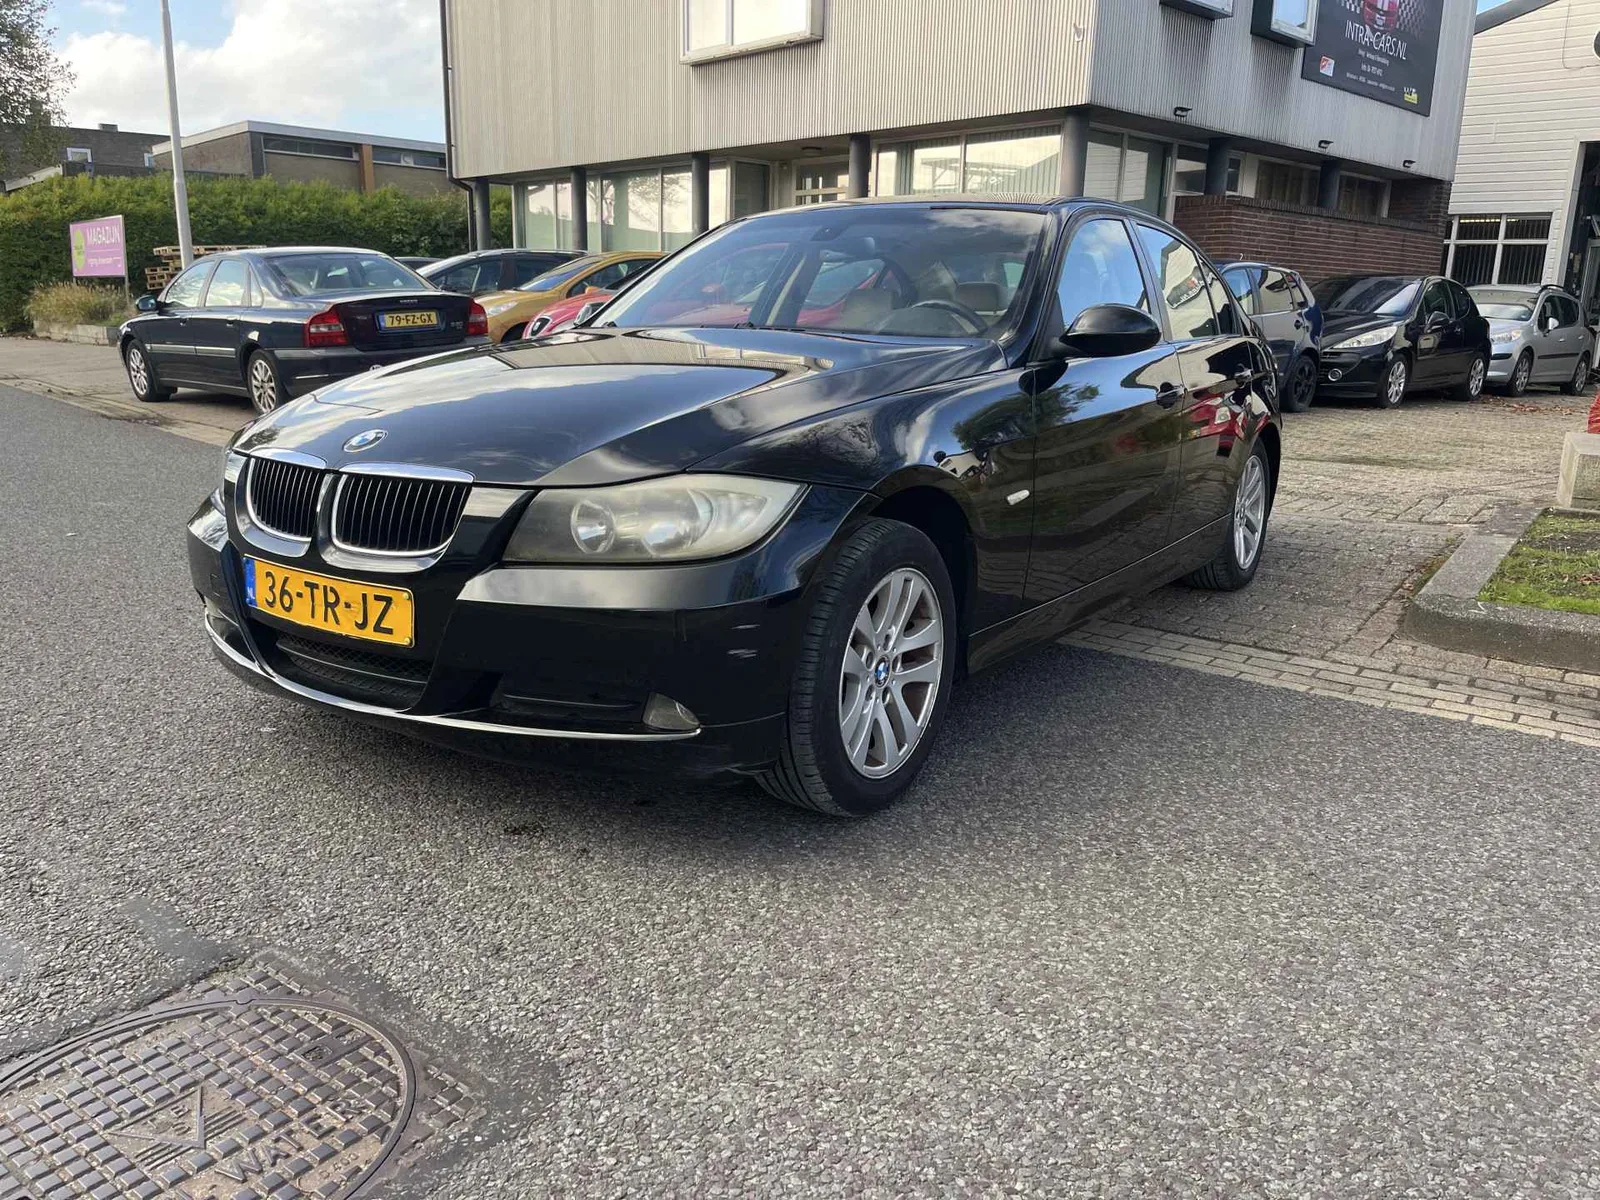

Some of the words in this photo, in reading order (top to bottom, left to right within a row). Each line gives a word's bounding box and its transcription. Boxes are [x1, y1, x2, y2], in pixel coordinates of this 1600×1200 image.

[1345, 20, 1407, 60] INTRA-CARS.NL
[389, 313, 433, 326] 79-FZ-GX
[264, 571, 394, 635] 36-TR-JZ
[214, 1101, 366, 1183] WATER
